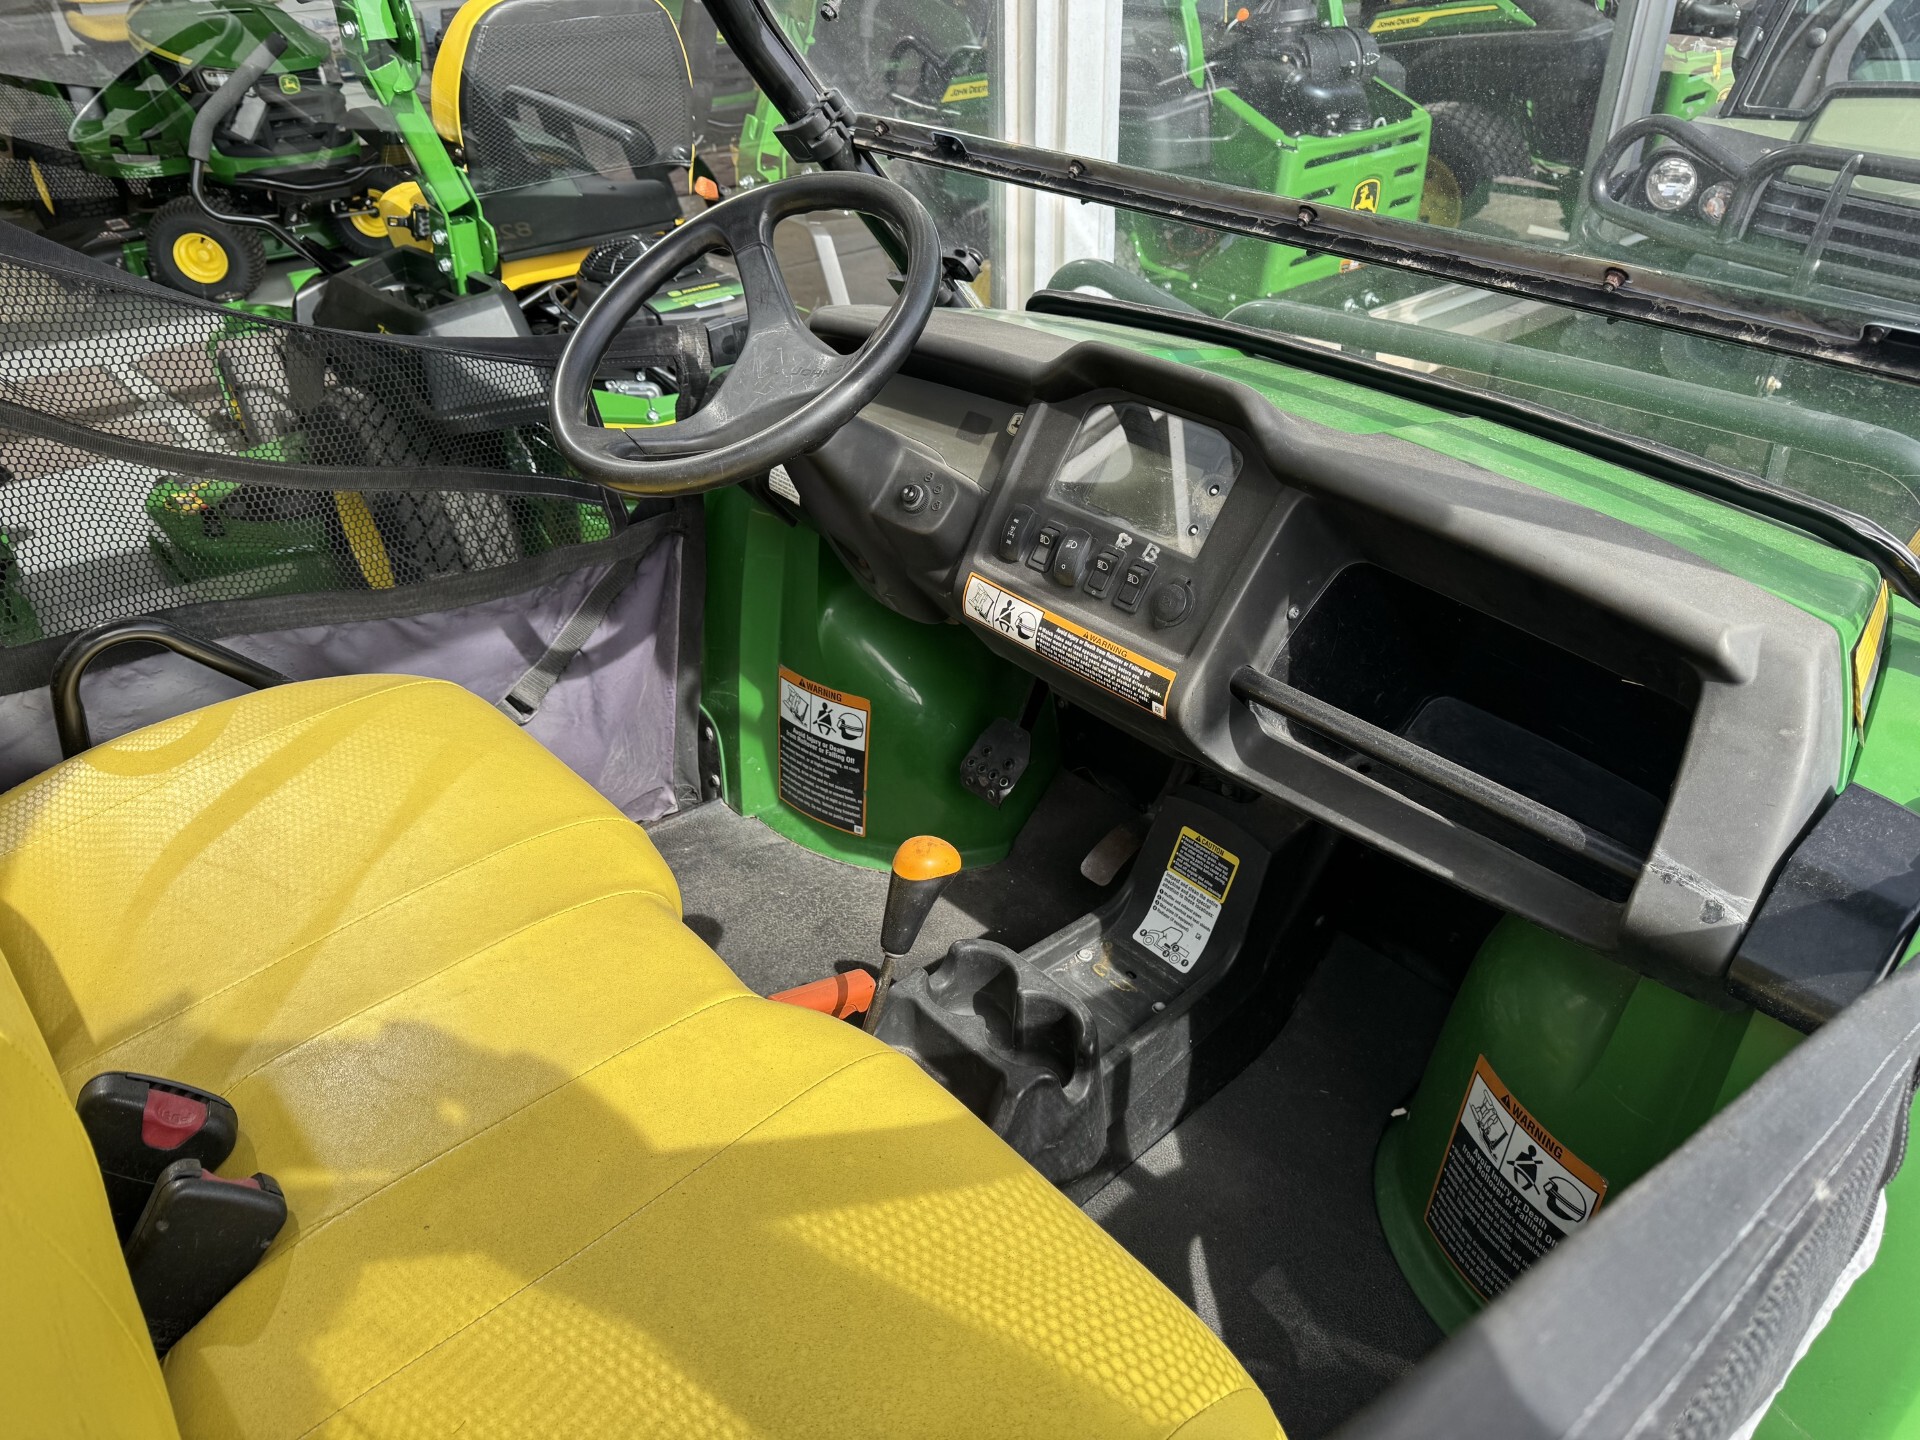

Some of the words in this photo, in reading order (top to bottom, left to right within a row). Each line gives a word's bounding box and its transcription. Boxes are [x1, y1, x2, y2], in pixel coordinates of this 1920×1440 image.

[1056, 628, 1068, 637] Avoid
[1067, 633, 1079, 644] Injury
[1084, 641, 1096, 651] Death
[1096, 647, 1106, 656] from
[1106, 652, 1123, 664] Rollover
[1128, 663, 1144, 676] Falling
[1089, 635, 1128, 658] WARNING
[807, 680, 842, 703] WARNING
[826, 750, 845, 762] Falling
[846, 756, 855, 764] Off
[829, 744, 846, 756] Death
[1202, 839, 1225, 856] CAUTION
[1512, 1102, 1564, 1162] WARNING
[1462, 1143, 1477, 1166] from
[1476, 1163, 1504, 1200] Rollover
[1505, 1197, 1514, 1210] or
[1514, 1206, 1543, 1238] Falling
[1473, 1147, 1491, 1173] Avoid
[1491, 1170, 1513, 1199] Injury
[1513, 1195, 1522, 1207] or
[1523, 1203, 1548, 1231] Death
